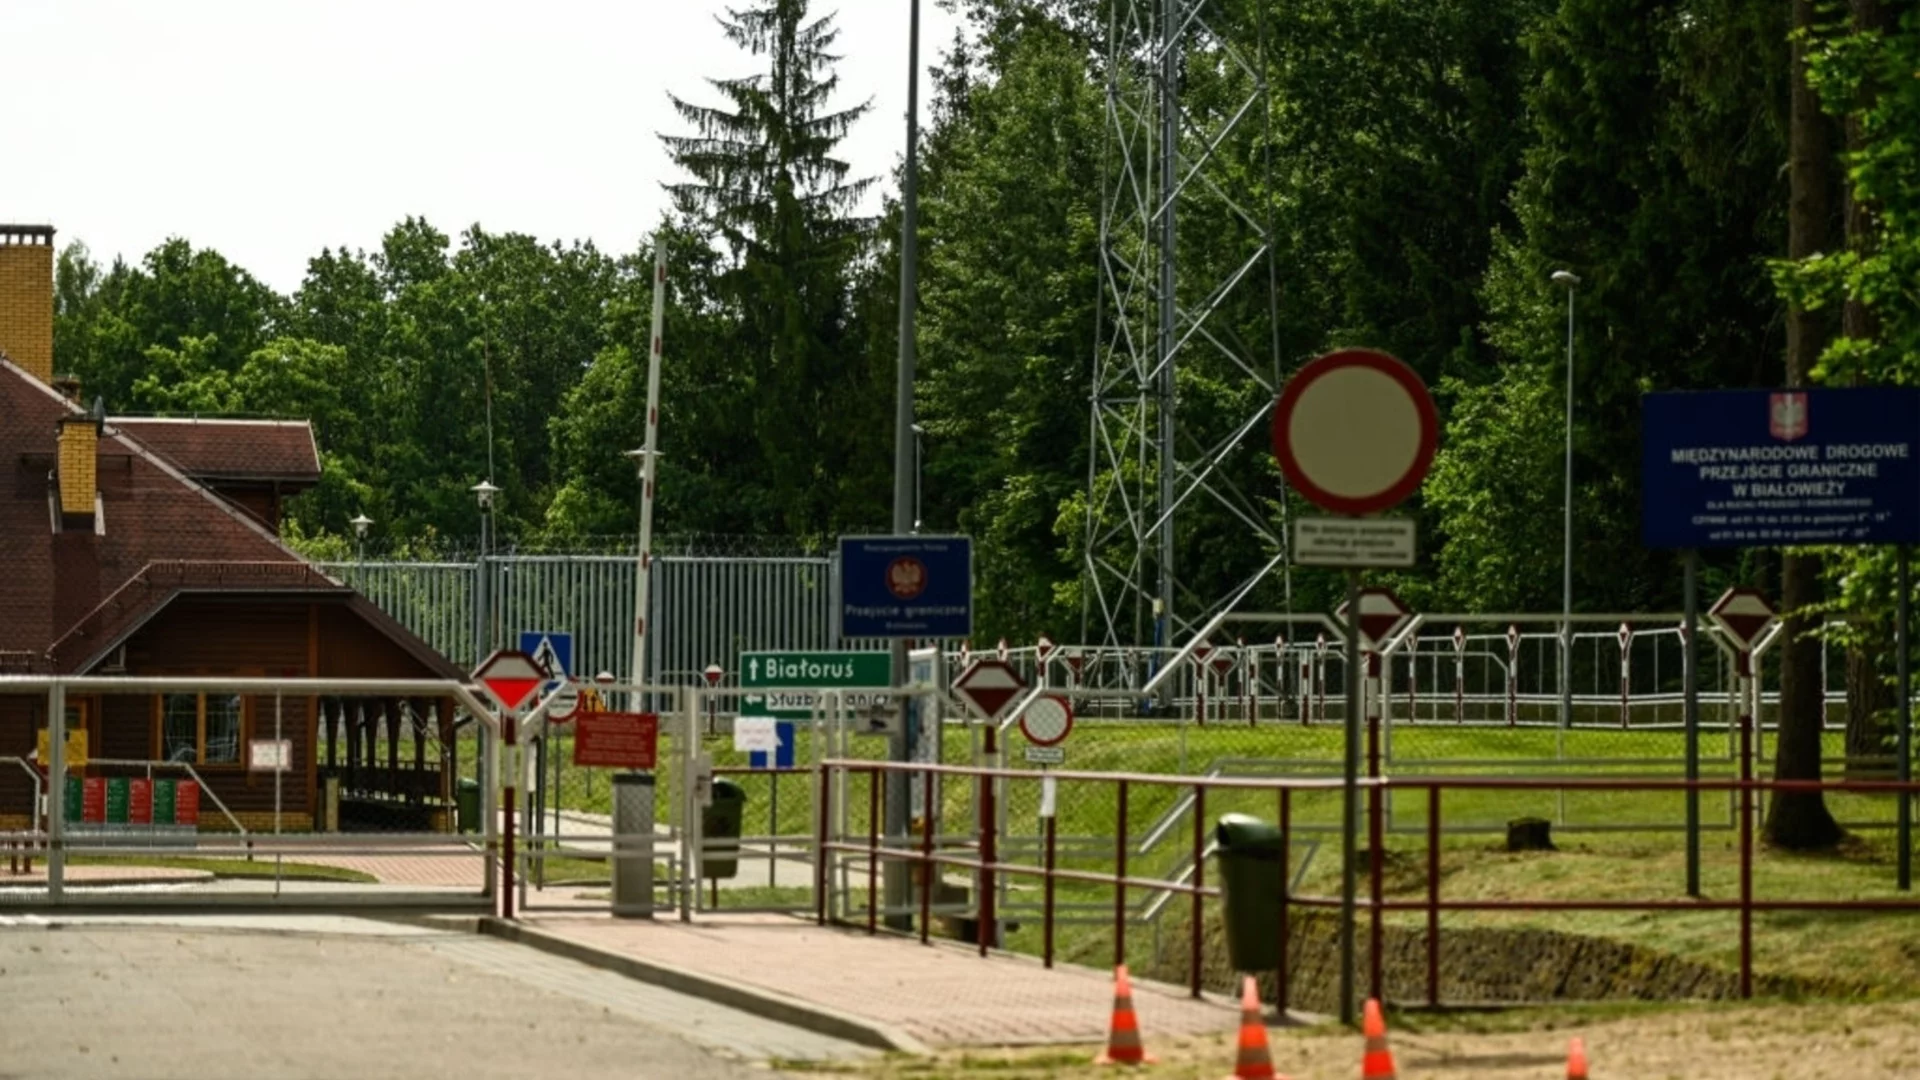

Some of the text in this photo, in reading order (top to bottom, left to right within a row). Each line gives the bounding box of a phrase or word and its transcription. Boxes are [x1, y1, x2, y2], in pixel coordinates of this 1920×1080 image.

[1671, 443, 1908, 465] MIĘDZYNARODOWE DROGOWE
[1700, 462, 1878, 480] PRZEJŚCIE GRANICZNE
[1732, 481, 1846, 498] W BIAŁOWIEŻY
[766, 658, 854, 678] Białoruś
